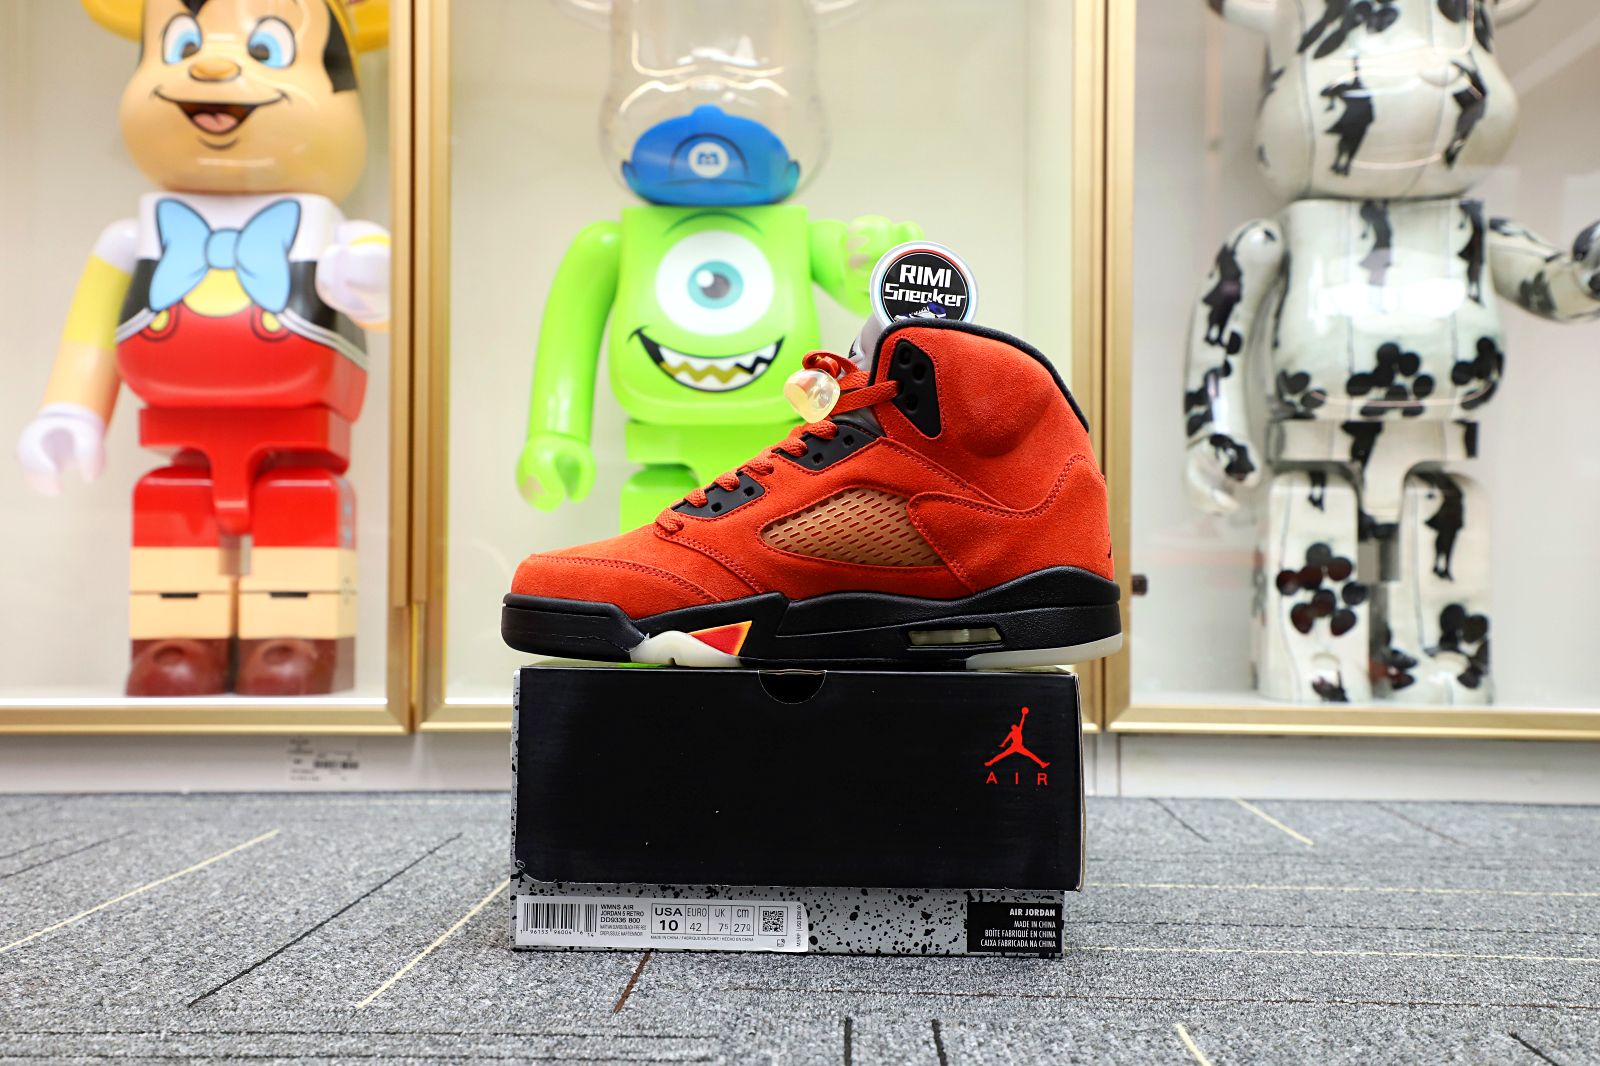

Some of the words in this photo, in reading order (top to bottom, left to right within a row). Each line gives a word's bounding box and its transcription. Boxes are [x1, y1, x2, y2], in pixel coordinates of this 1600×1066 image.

[900, 264, 952, 288] RIMI
[884, 282, 966, 307] Sneaker
[985, 771, 1048, 786] AIR
[654, 907, 683, 917] USA
[687, 908, 707, 917] EURO
[714, 908, 726, 918] UK
[1009, 908, 1023, 916] AIR
[1025, 908, 1056, 917] JORDAN
[659, 920, 679, 931] 10
[689, 922, 702, 932] 42
[1013, 920, 1030, 928] MADE
[1031, 920, 1038, 928] IN
[1038, 920, 1056, 928] CHINA
[1030, 930, 1038, 938] EN
[1038, 930, 1057, 938] CHINA
[980, 938, 997, 947] CAIXA
[997, 939, 1029, 948] FABRICADA
[1029, 940, 1038, 948] NA
[1038, 940, 1057, 948] CHINA
